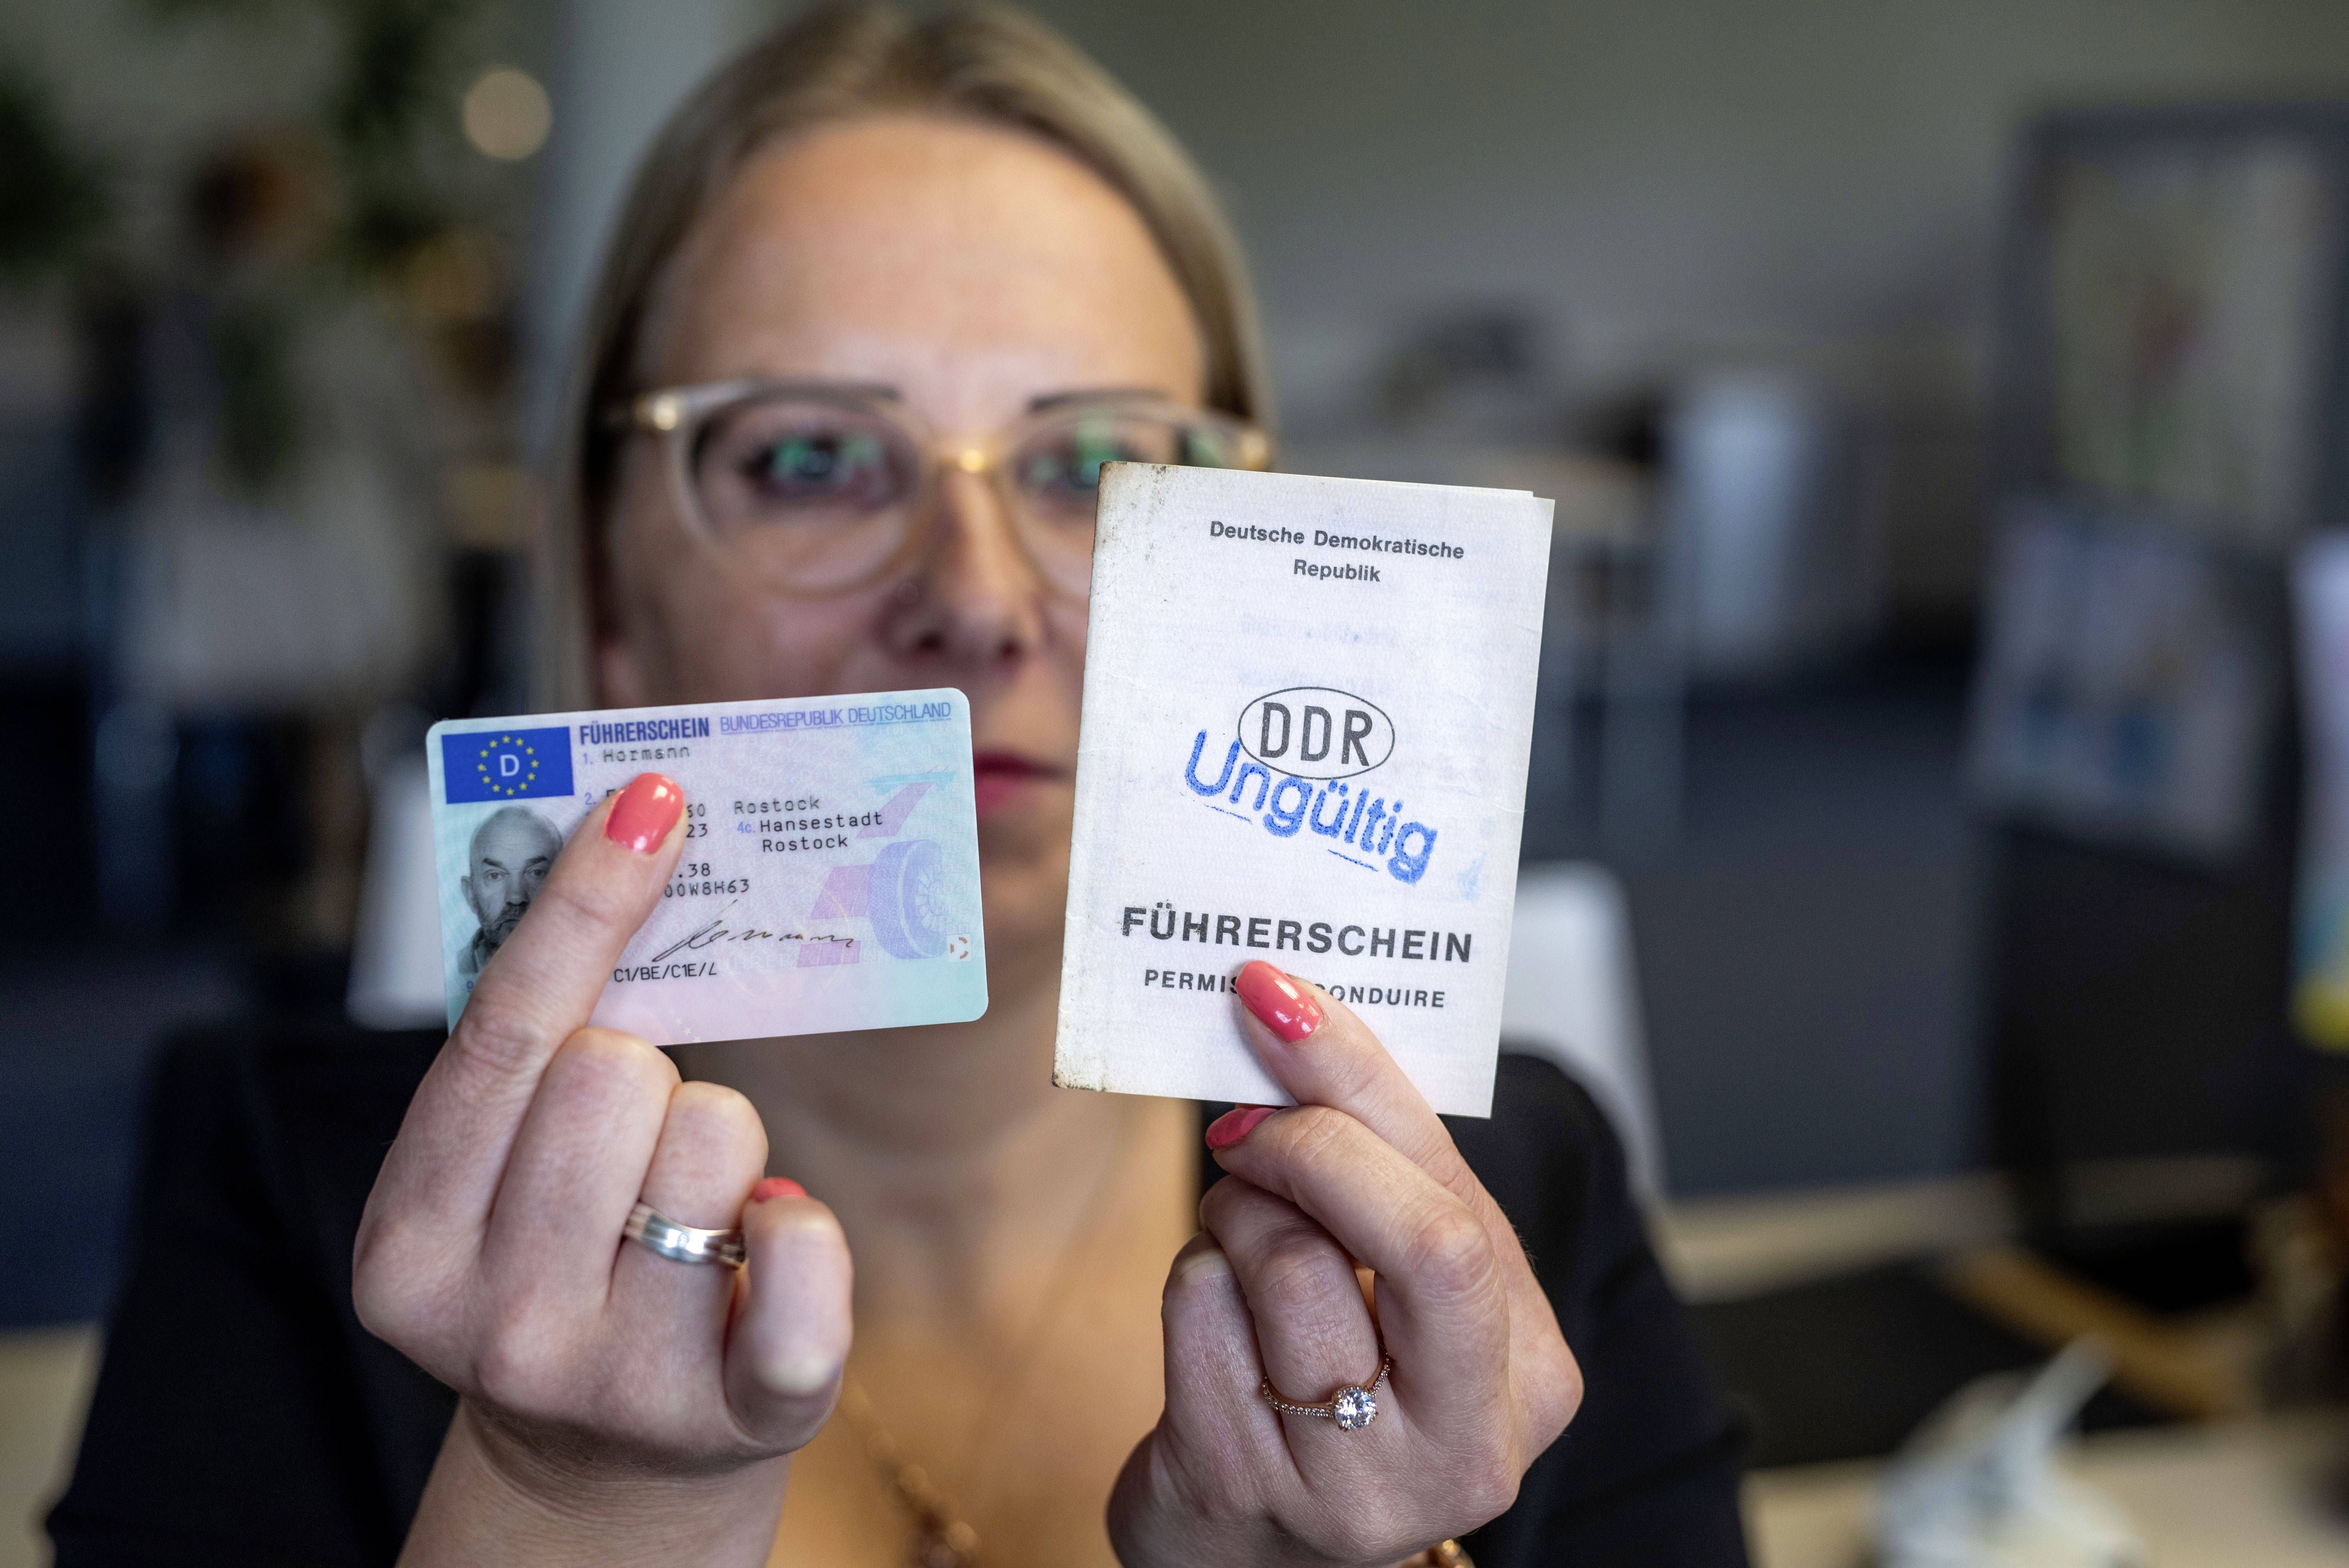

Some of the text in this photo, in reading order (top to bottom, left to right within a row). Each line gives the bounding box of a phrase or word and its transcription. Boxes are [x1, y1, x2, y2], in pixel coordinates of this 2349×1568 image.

[1210, 520, 1465, 559] Deutsche Demokratische
[1294, 559, 1381, 583] Republik
[580, 702, 951, 745] FÜHRERSCHEIN BUNDESREPUBLIK DEUTSCHLAND
[1259, 702, 1374, 767] DDR
[500, 754, 520, 777] D
[604, 747, 690, 762] Hormann
[734, 796, 820, 814] Rostock
[1185, 729, 1438, 886] Ungültig
[760, 811, 883, 832] Hansestadt
[763, 834, 848, 852] Rostock
[1122, 900, 1472, 963] FÜHRERSCHEIN
